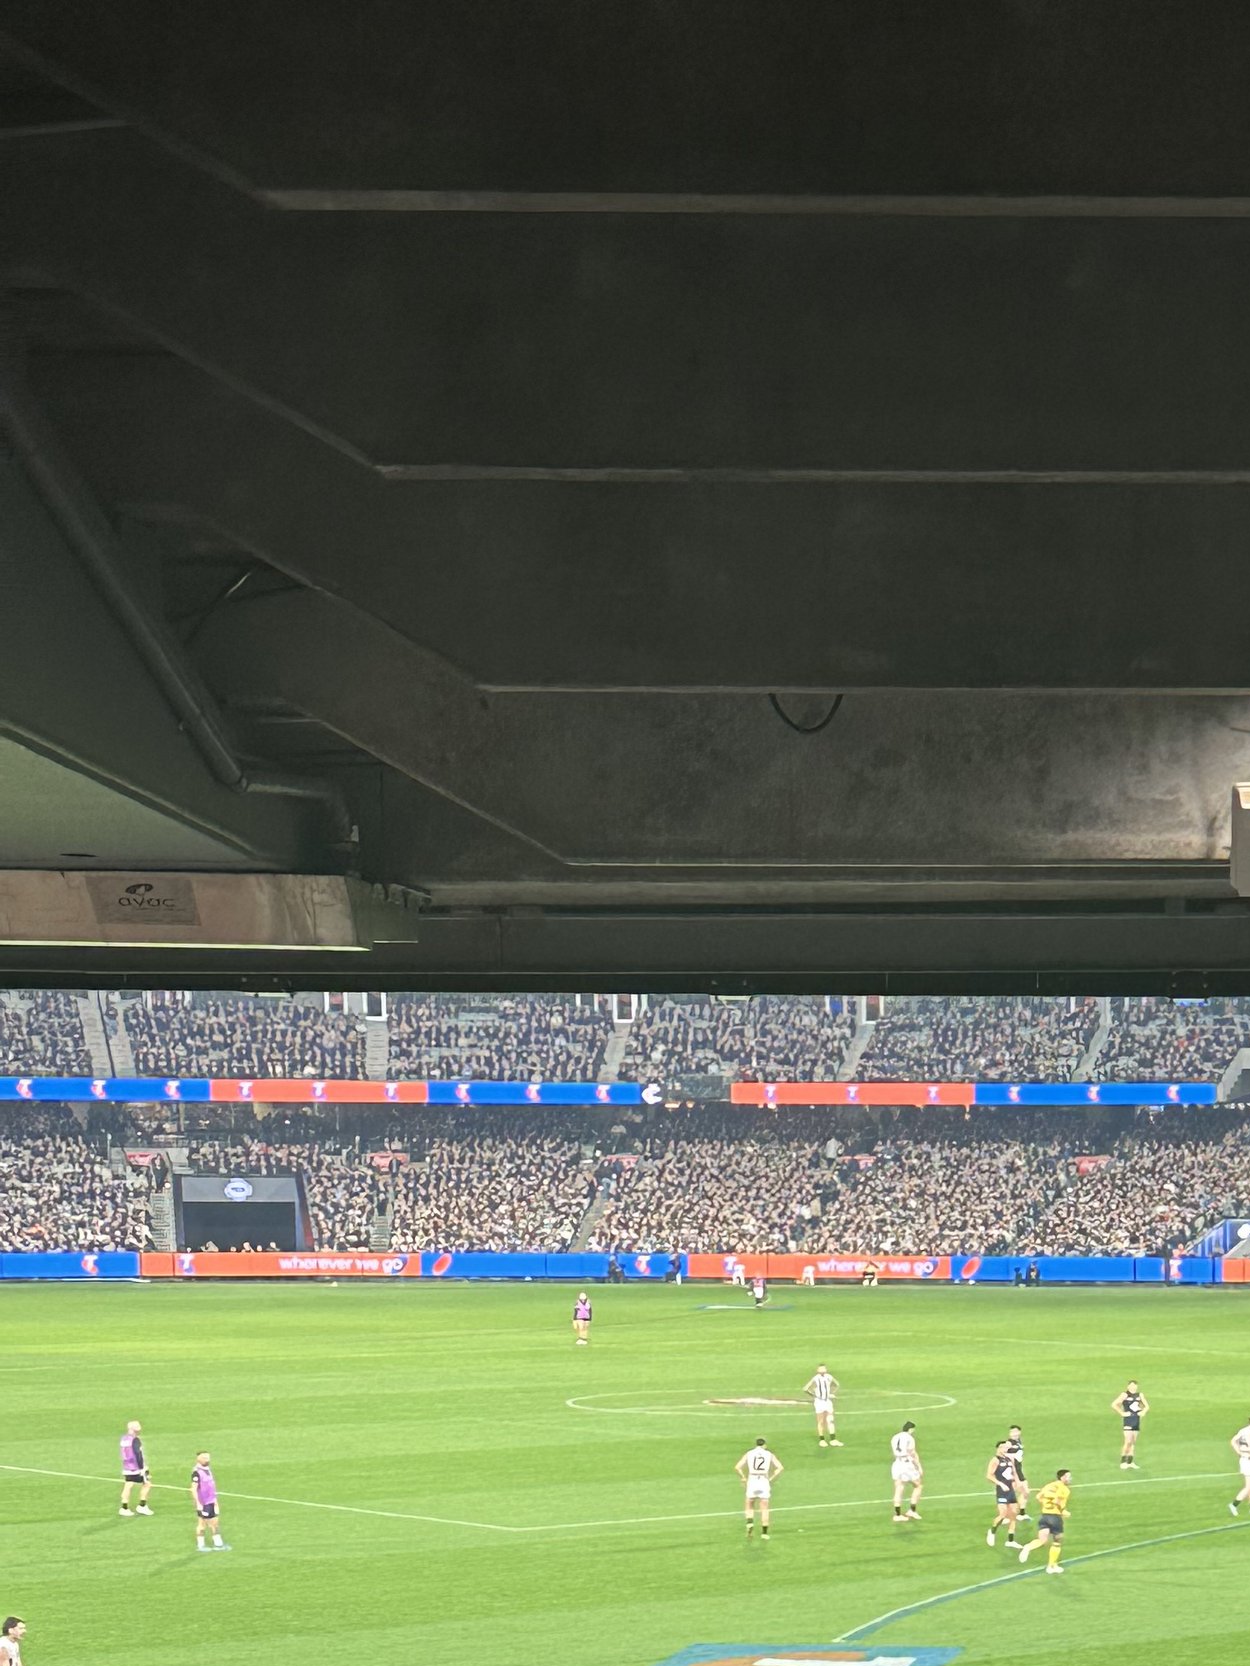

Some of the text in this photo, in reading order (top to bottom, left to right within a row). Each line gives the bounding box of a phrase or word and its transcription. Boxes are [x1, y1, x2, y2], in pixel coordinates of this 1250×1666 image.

[278, 1256, 353, 1270] wherever
[355, 1258, 379, 1271] we
[888, 1261, 911, 1274] we
[753, 1456, 765, 1471] 12
